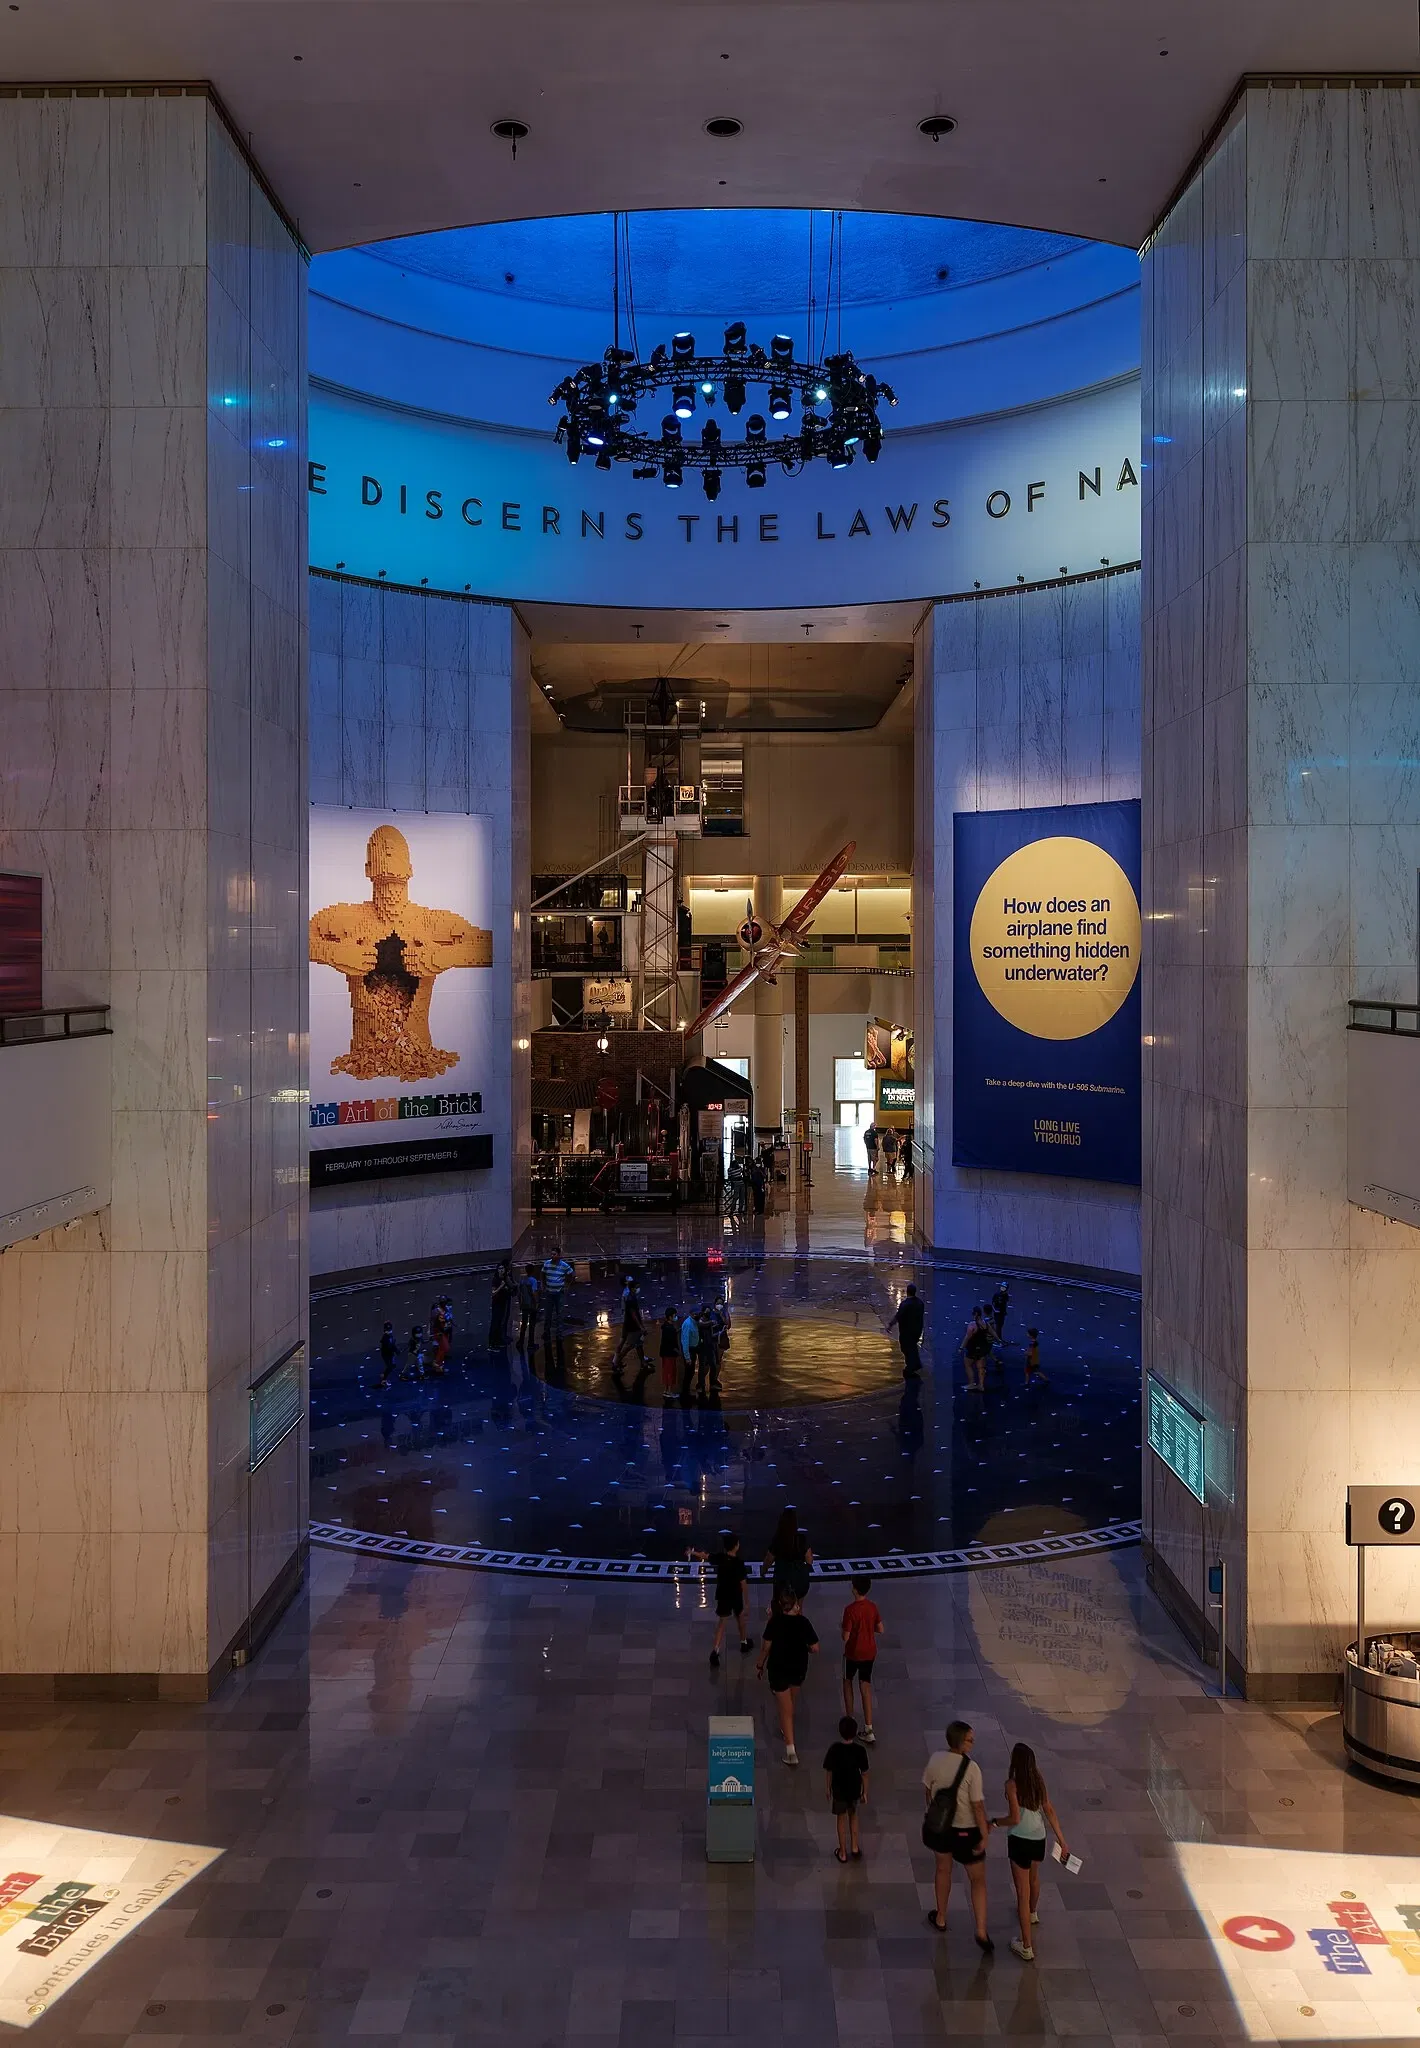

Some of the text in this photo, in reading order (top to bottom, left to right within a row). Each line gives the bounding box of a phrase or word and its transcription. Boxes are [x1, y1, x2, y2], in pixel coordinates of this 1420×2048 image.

[362, 476, 643, 541] DISCERNS
[677, 514, 779, 543] THE
[817, 498, 952, 541] LAWS
[986, 482, 1046, 519] OF
[1079, 457, 1138, 500] NA
[543, 863, 581, 872] AGASSIZ
[848, 863, 900, 871] DESMAREST
[1004, 897, 1110, 914] How does an
[1007, 919, 1106, 939] airplane find
[983, 942, 1129, 961] something hidden
[1005, 964, 1108, 981] underwater?
[1008, 1080, 1024, 1088] deep
[1090, 1085, 1125, 1094] Submarine.
[309, 1098, 478, 1127] The Art of the Brick
[1034, 1120, 1080, 1133] LONG LIVE
[325, 1160, 362, 1172] FEBRUARY
[364, 1159, 372, 1167] 10
[373, 1156, 409, 1166] THROUGH
[409, 1152, 452, 1162] SEPTEMBER
[712, 1749, 751, 1758] help inspire
[35, 1888, 86, 1916] the
[25, 1859, 199, 2005] continues in Gallery 2
[28, 1904, 101, 1951] Brick
[1343, 1908, 1383, 1939] Art
[1326, 1933, 1365, 1972] The
